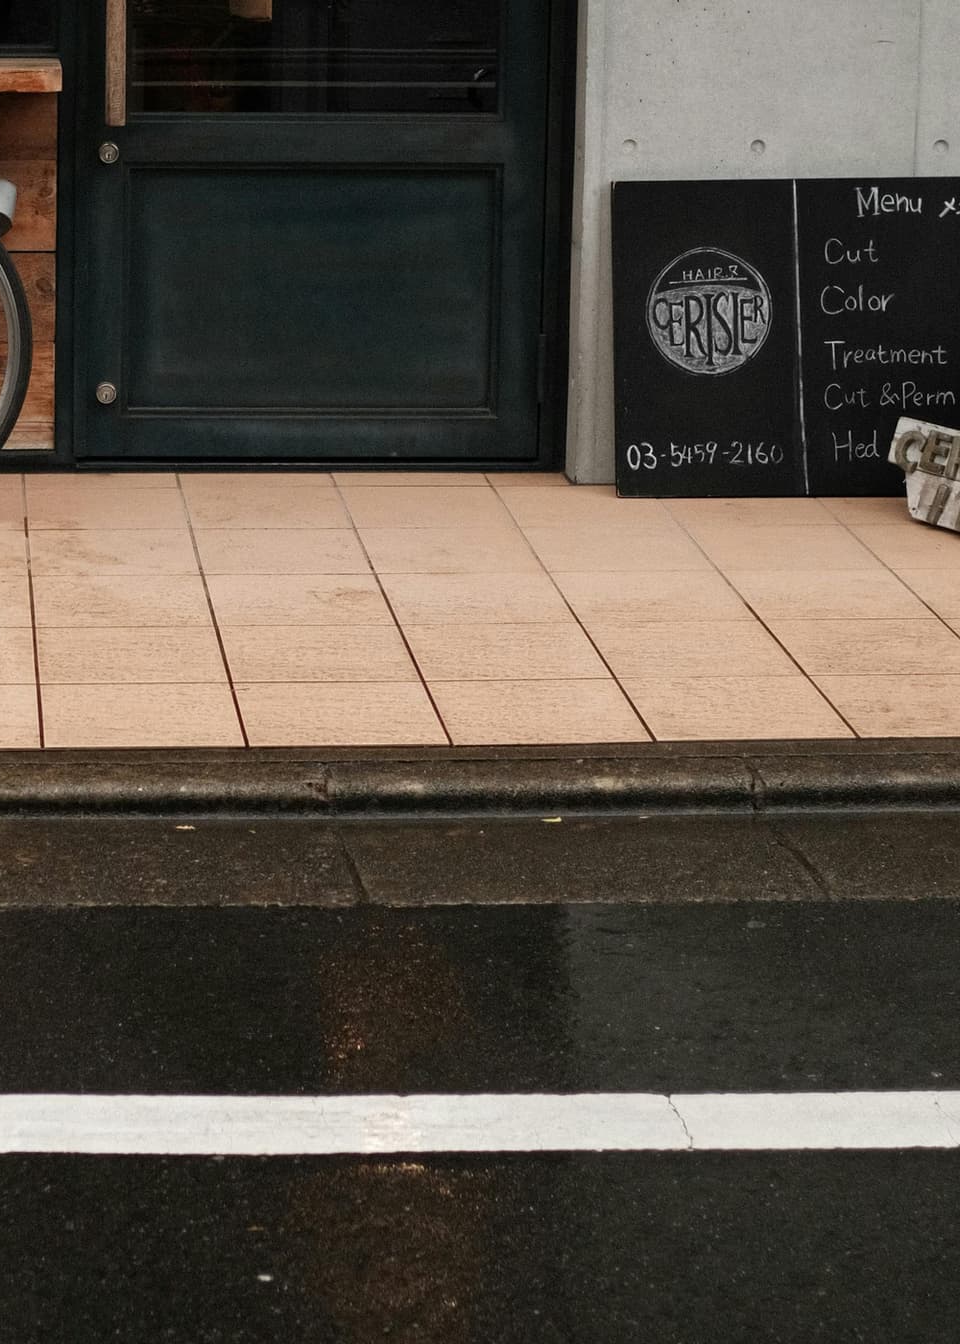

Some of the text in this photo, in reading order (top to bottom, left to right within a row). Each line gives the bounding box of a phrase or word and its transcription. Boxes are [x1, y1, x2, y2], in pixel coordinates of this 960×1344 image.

[855, 187, 922, 217] Menu
[825, 238, 878, 264] Cut
[821, 285, 894, 314] Color
[653, 291, 766, 366] CERISIER
[824, 341, 947, 370] Treatment
[824, 383, 870, 410] Cut
[627, 441, 783, 470] 03-5459-2160
[832, 430, 880, 461] Hed
